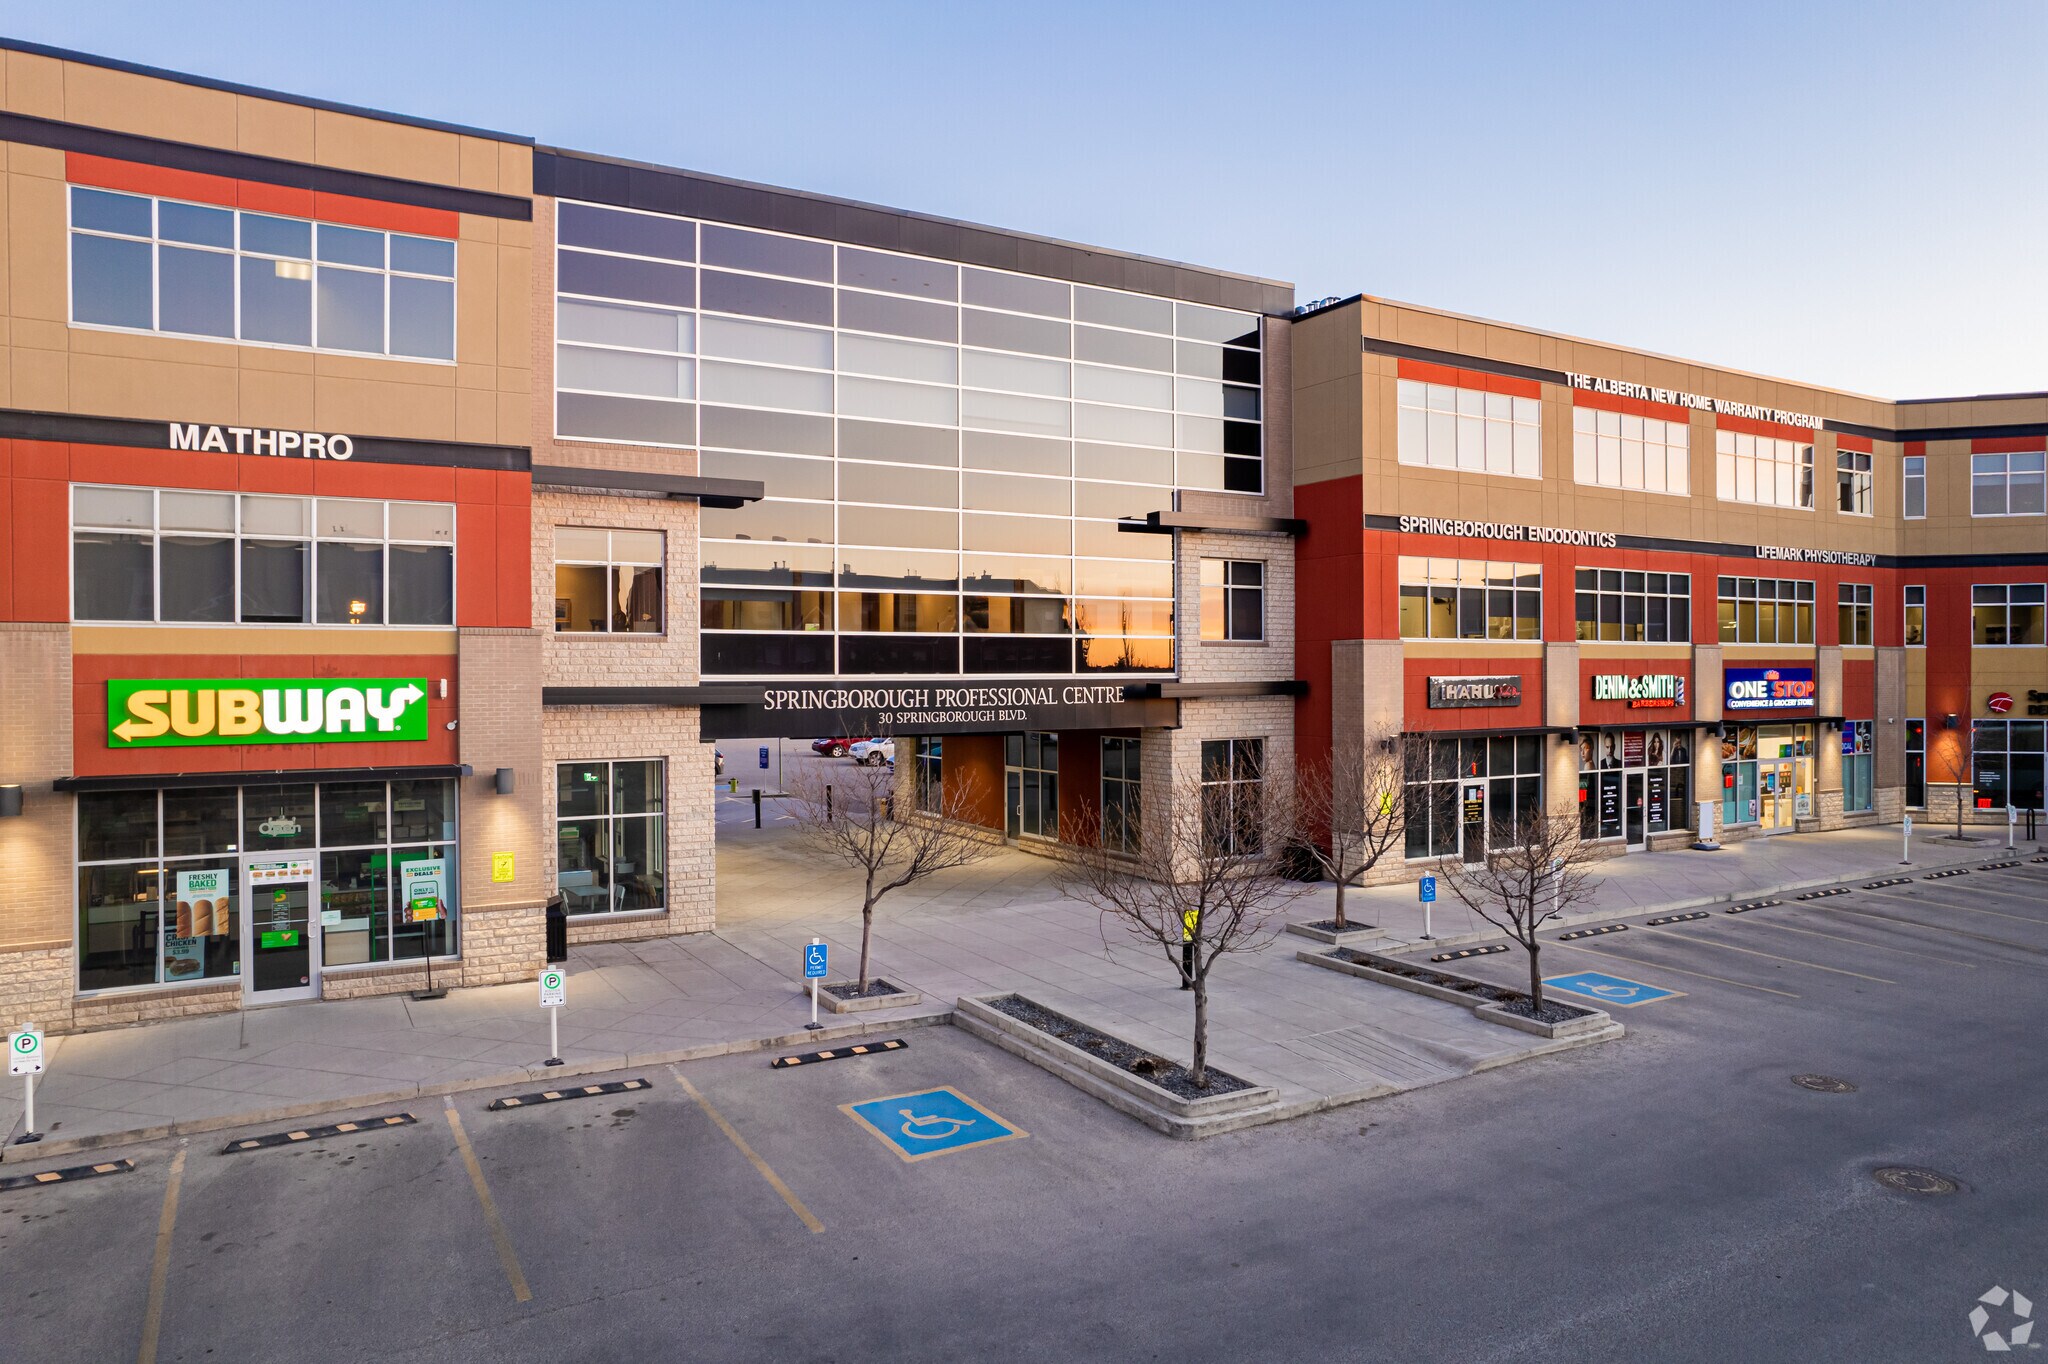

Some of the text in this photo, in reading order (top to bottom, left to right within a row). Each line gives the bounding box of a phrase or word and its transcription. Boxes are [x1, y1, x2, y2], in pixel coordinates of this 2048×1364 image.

[1565, 372, 1823, 430] THE ALBERTA NEW HOME WARRANTY PROGRAM
[169, 422, 353, 460] MATHPRO
[1400, 515, 1616, 548] SPRINGBOROUGH ENDODONTICS
[1756, 545, 1876, 566] LIFEMARK PHYSIOTHERAPY
[764, 686, 1125, 710] SPRINGBOROUGH PROFESSIONAL CENTRE
[1730, 680, 1815, 699] ONE STOP
[112, 683, 425, 742] SUBWAY
[1730, 700, 1769, 708] CONVENIENCE
[1774, 699, 1797, 707] GROCERY
[1797, 698, 1815, 706] STORE
[878, 709, 1028, 724] 30 SPRINGBOROUGH BLVD.
[189, 880, 216, 888] BAKED
[165, 939, 197, 947] CHICKEN
